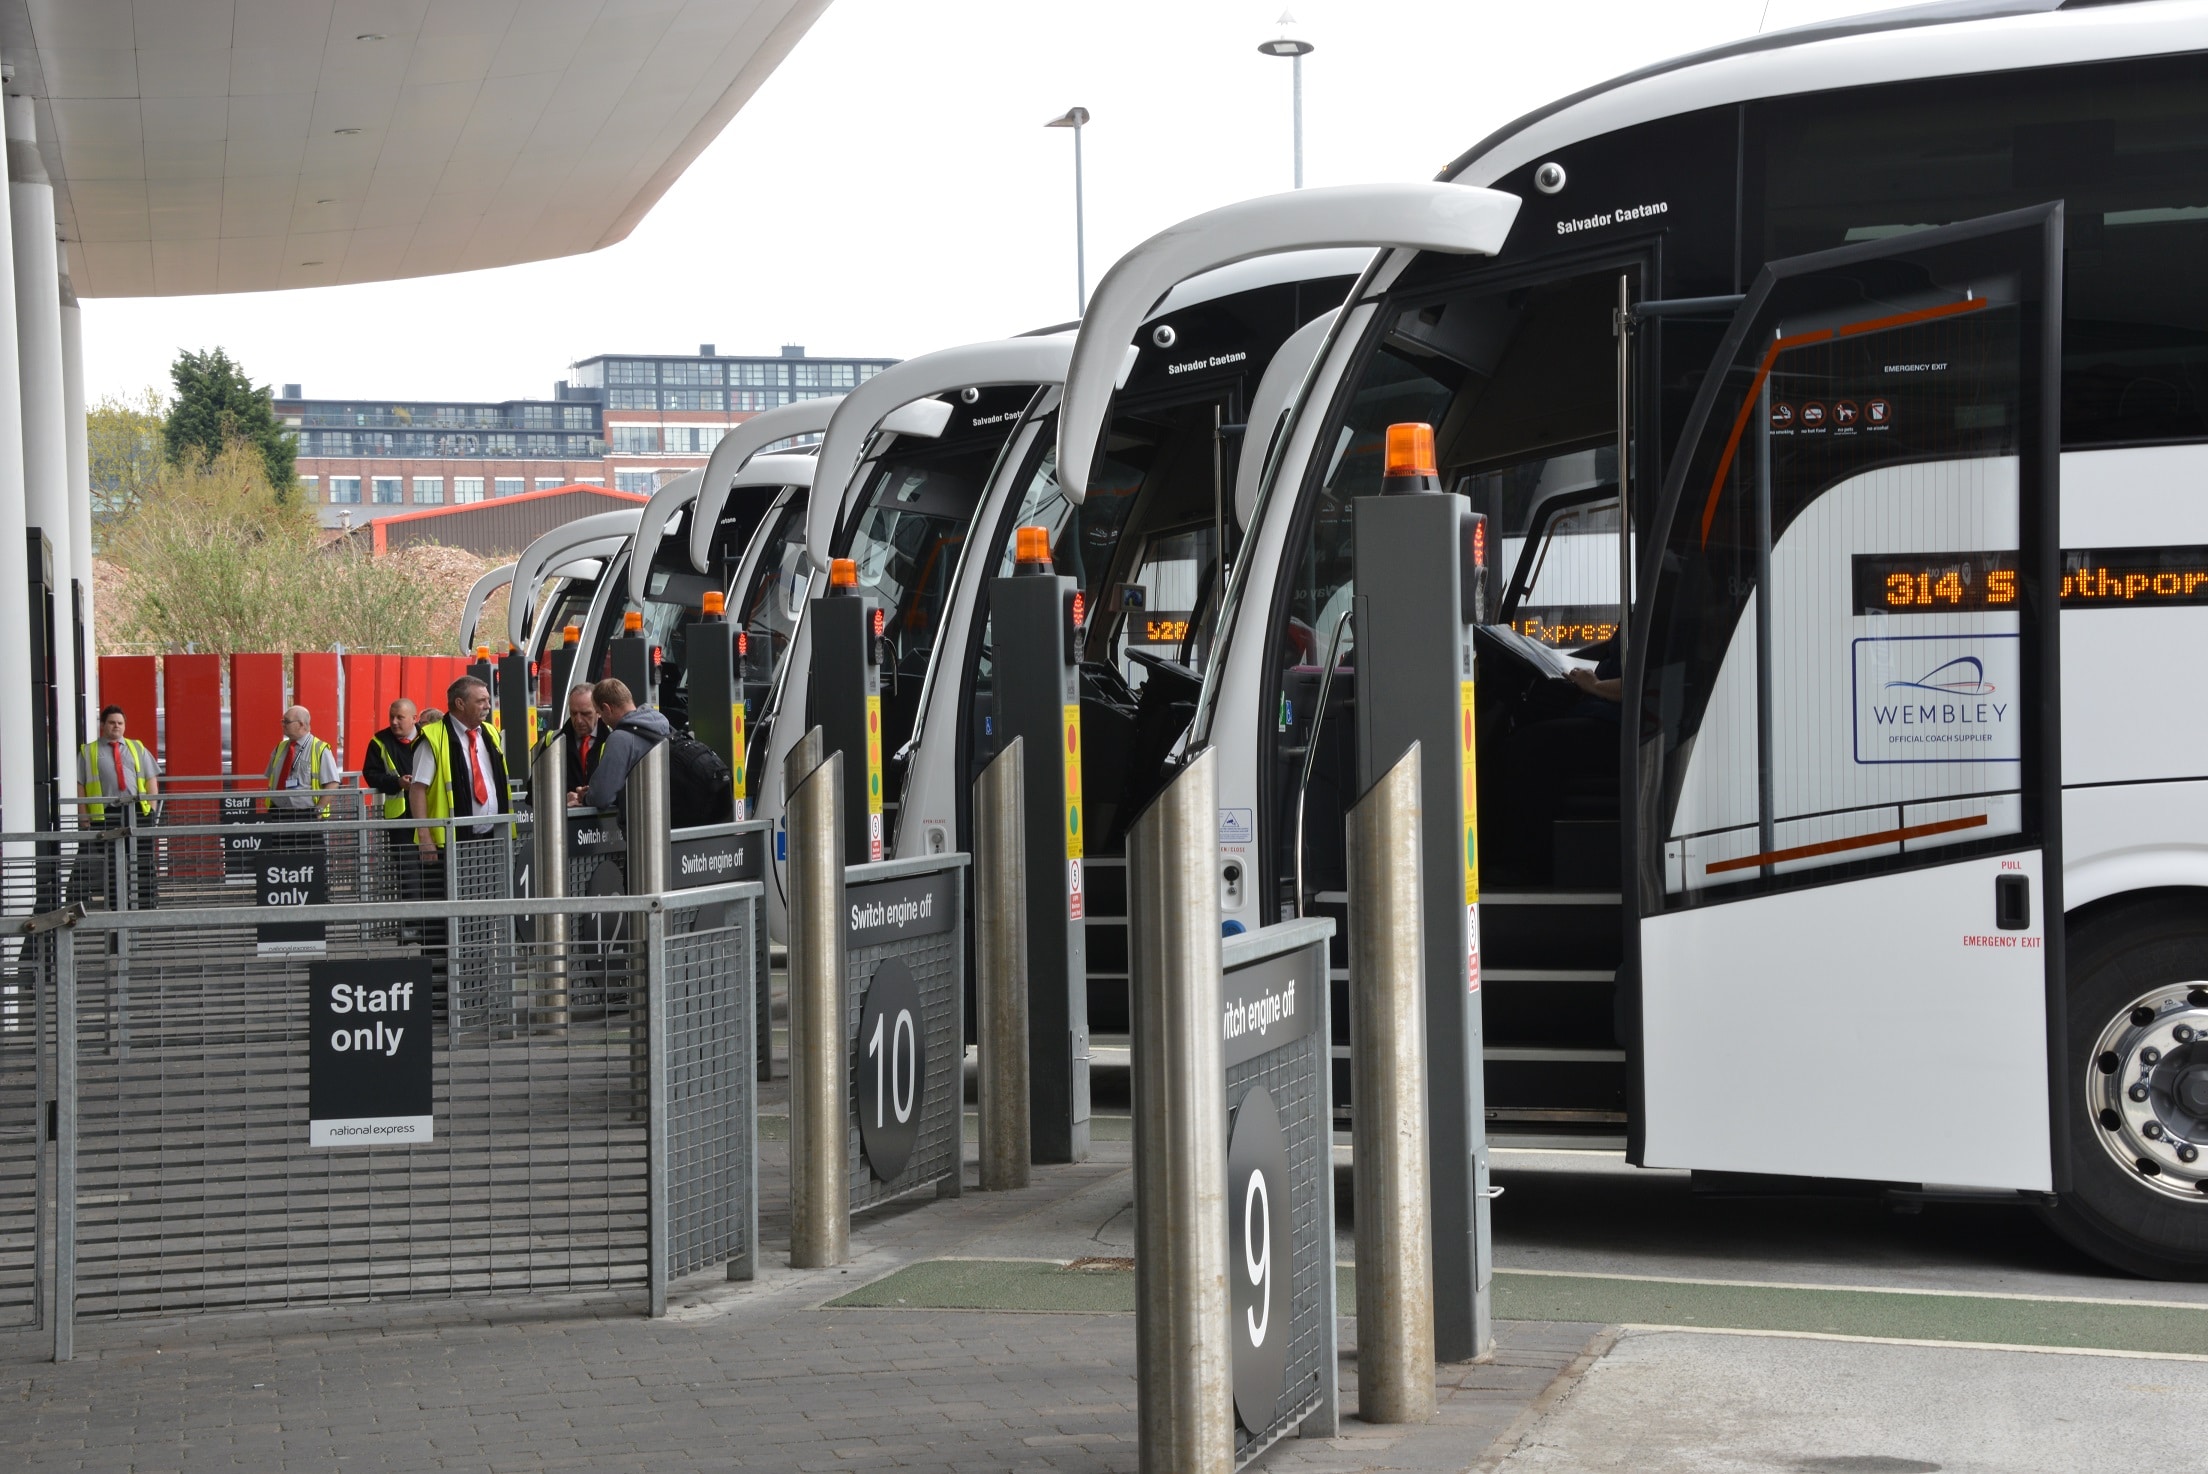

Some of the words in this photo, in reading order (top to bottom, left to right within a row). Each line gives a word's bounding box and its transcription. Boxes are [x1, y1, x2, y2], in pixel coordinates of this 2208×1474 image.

[1556, 214, 1612, 235] Salvador
[1614, 202, 1668, 222] Caetano
[1168, 360, 1208, 375] Salvador
[1209, 351, 1247, 367] Caetano
[1884, 363, 1930, 373] EMERGENCY
[1931, 363, 1948, 371] EXIT
[972, 414, 1003, 427] Salvador
[1887, 572, 1962, 605] 314
[1873, 703, 2008, 725] WEMBLEY
[1888, 735, 1924, 743] OFFICIAL
[1954, 734, 1993, 742] SUPPLIER
[224, 798, 251, 808] Staff
[232, 836, 262, 851] only
[577, 828, 601, 846] Switch
[681, 852, 708, 875] Switch
[708, 850, 733, 874] engine
[733, 848, 744, 867] off
[2001, 861, 2022, 869] PULL
[266, 866, 314, 884] Staff
[267, 887, 309, 906] only
[851, 900, 885, 931] Switch
[886, 898, 918, 928] engine
[919, 893, 933, 919] off
[1963, 935, 2017, 947] EMERGENCY
[2021, 937, 2041, 948] EXIT
[330, 982, 414, 1014] Staff
[1223, 997, 1246, 1041] itch
[1248, 988, 1281, 1036] engine
[1282, 979, 1295, 1018] off
[330, 1020, 404, 1057] only
[869, 1008, 916, 1129] 10
[329, 1125, 372, 1136] national
[373, 1124, 415, 1136] express
[1245, 1168, 1271, 1348] 9
